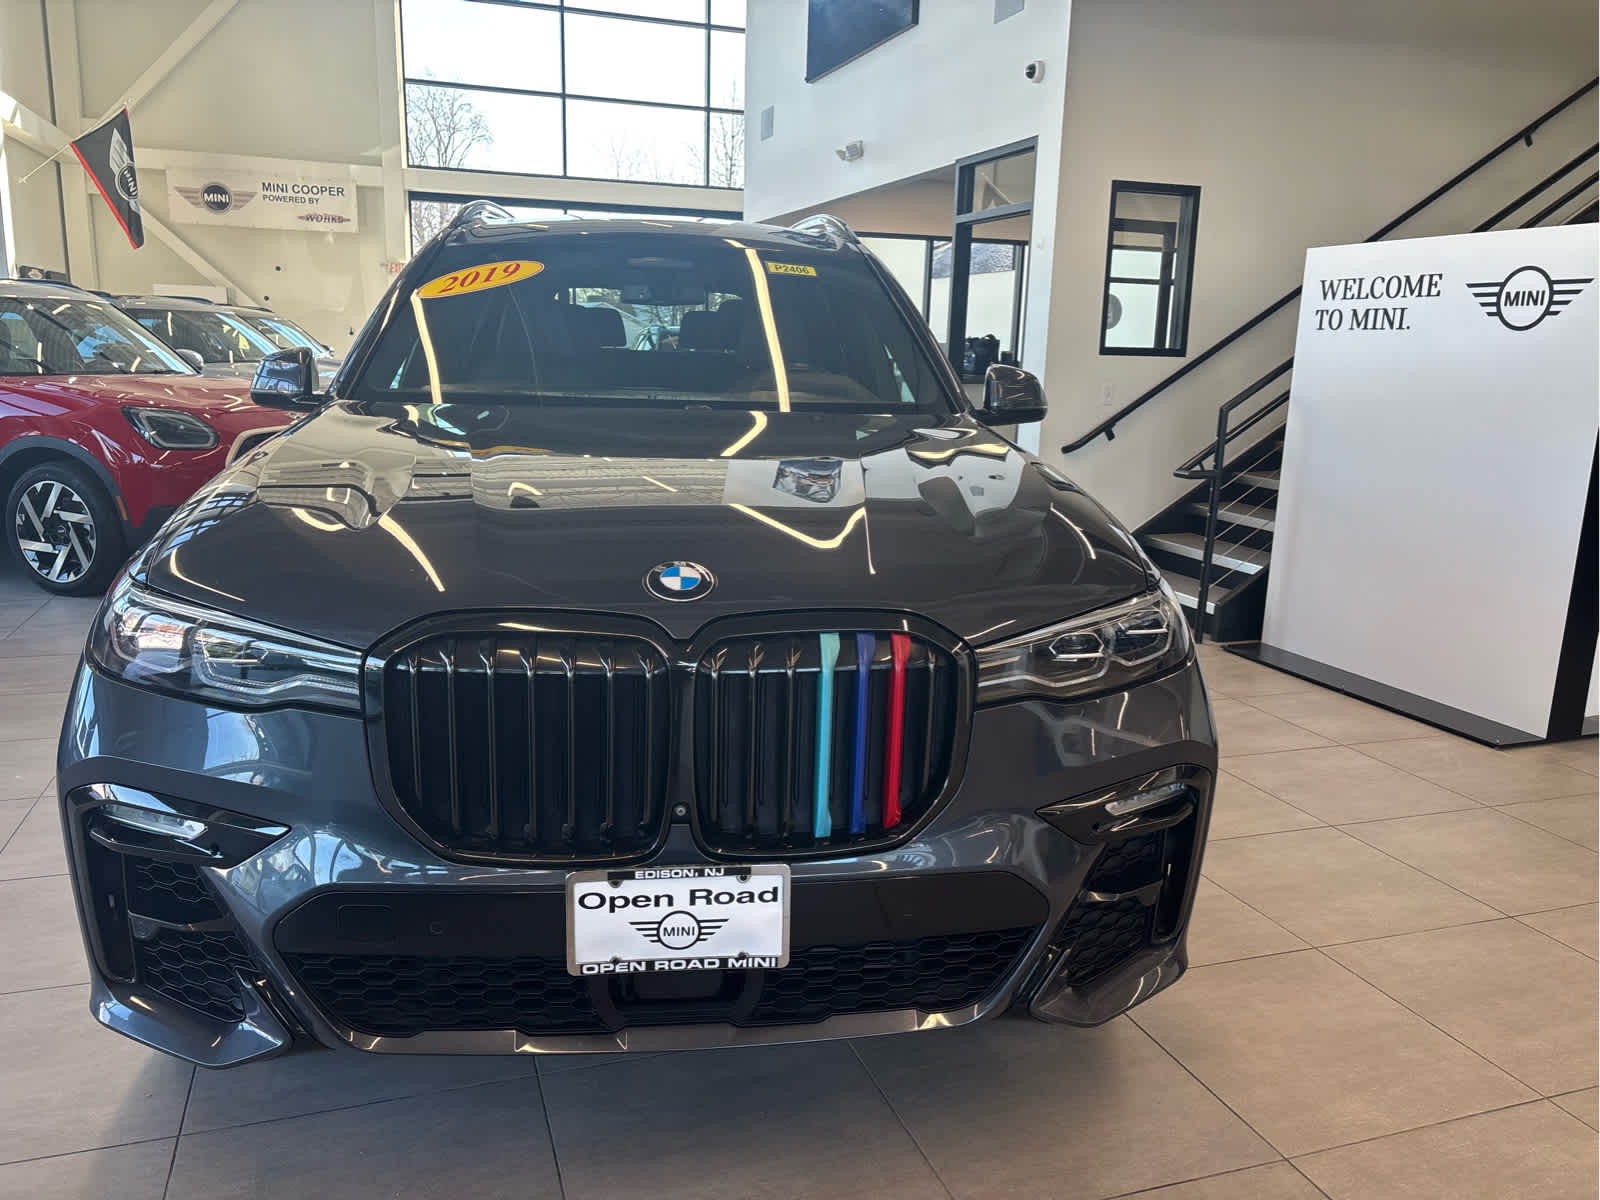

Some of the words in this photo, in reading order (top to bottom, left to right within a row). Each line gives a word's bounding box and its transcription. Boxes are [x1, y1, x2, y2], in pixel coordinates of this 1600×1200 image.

[261, 182, 289, 194] MINI
[291, 184, 345, 197] COOPER
[203, 193, 230, 204] MINI
[262, 195, 306, 204] POWERED
[308, 197, 320, 205] BY
[774, 264, 810, 274] P2406
[438, 262, 521, 294] 2019
[1319, 273, 1443, 301] WELCOME
[1503, 290, 1546, 307] MINI
[1315, 308, 1344, 331] TO
[1349, 307, 1411, 331] MINI.
[704, 867, 725, 877] NJ
[577, 892, 674, 913] Open
[689, 886, 779, 906] Road
[662, 926, 696, 938] MINI
[581, 961, 647, 975] OPEN
[654, 958, 721, 971] ROAD
[727, 957, 777, 969] MINI
